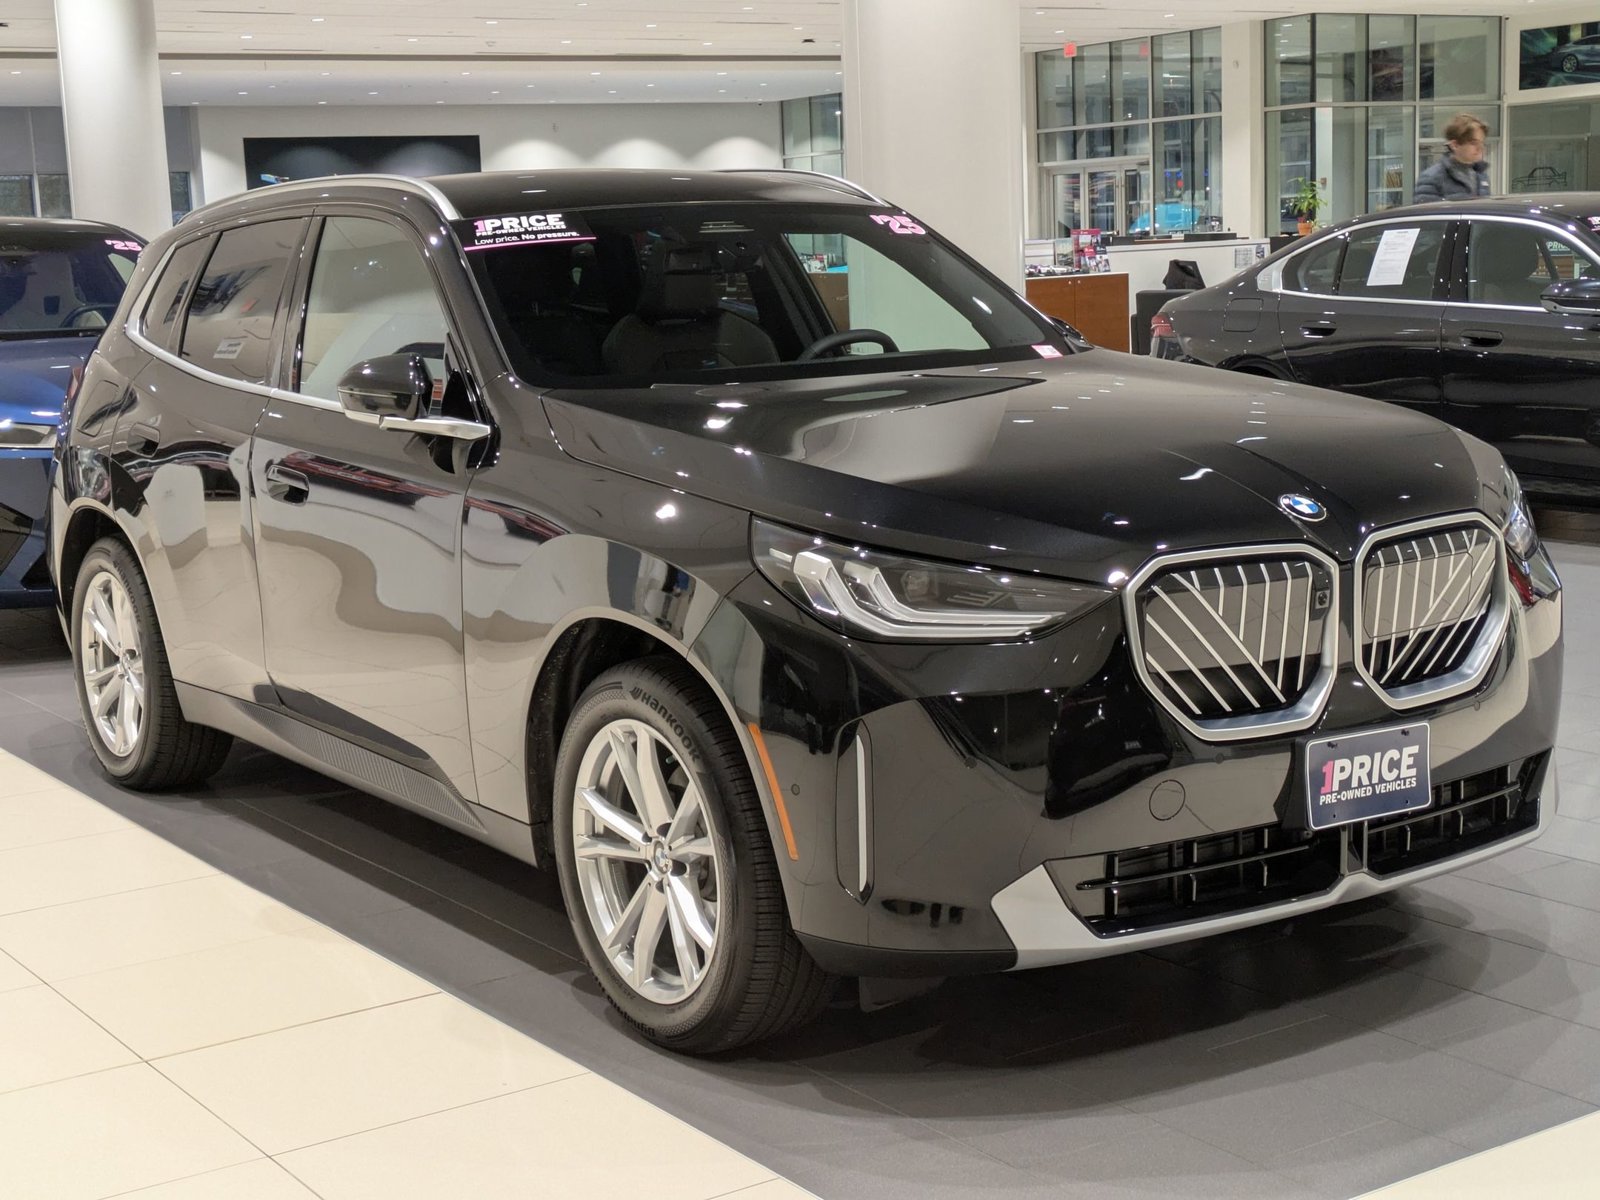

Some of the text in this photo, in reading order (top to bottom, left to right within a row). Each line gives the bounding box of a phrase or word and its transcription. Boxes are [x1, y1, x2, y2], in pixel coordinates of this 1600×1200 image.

[474, 213, 565, 232] 1PRICE
[476, 224, 567, 237] PRE-OWNED VEHICLES
[869, 214, 926, 235] '25
[495, 234, 520, 245] price.
[521, 232, 536, 240] No
[537, 231, 580, 240] pressure.
[1320, 745, 1420, 794] 1PRICE
[1319, 777, 1417, 806] PRE-OWNED VEHICLES
